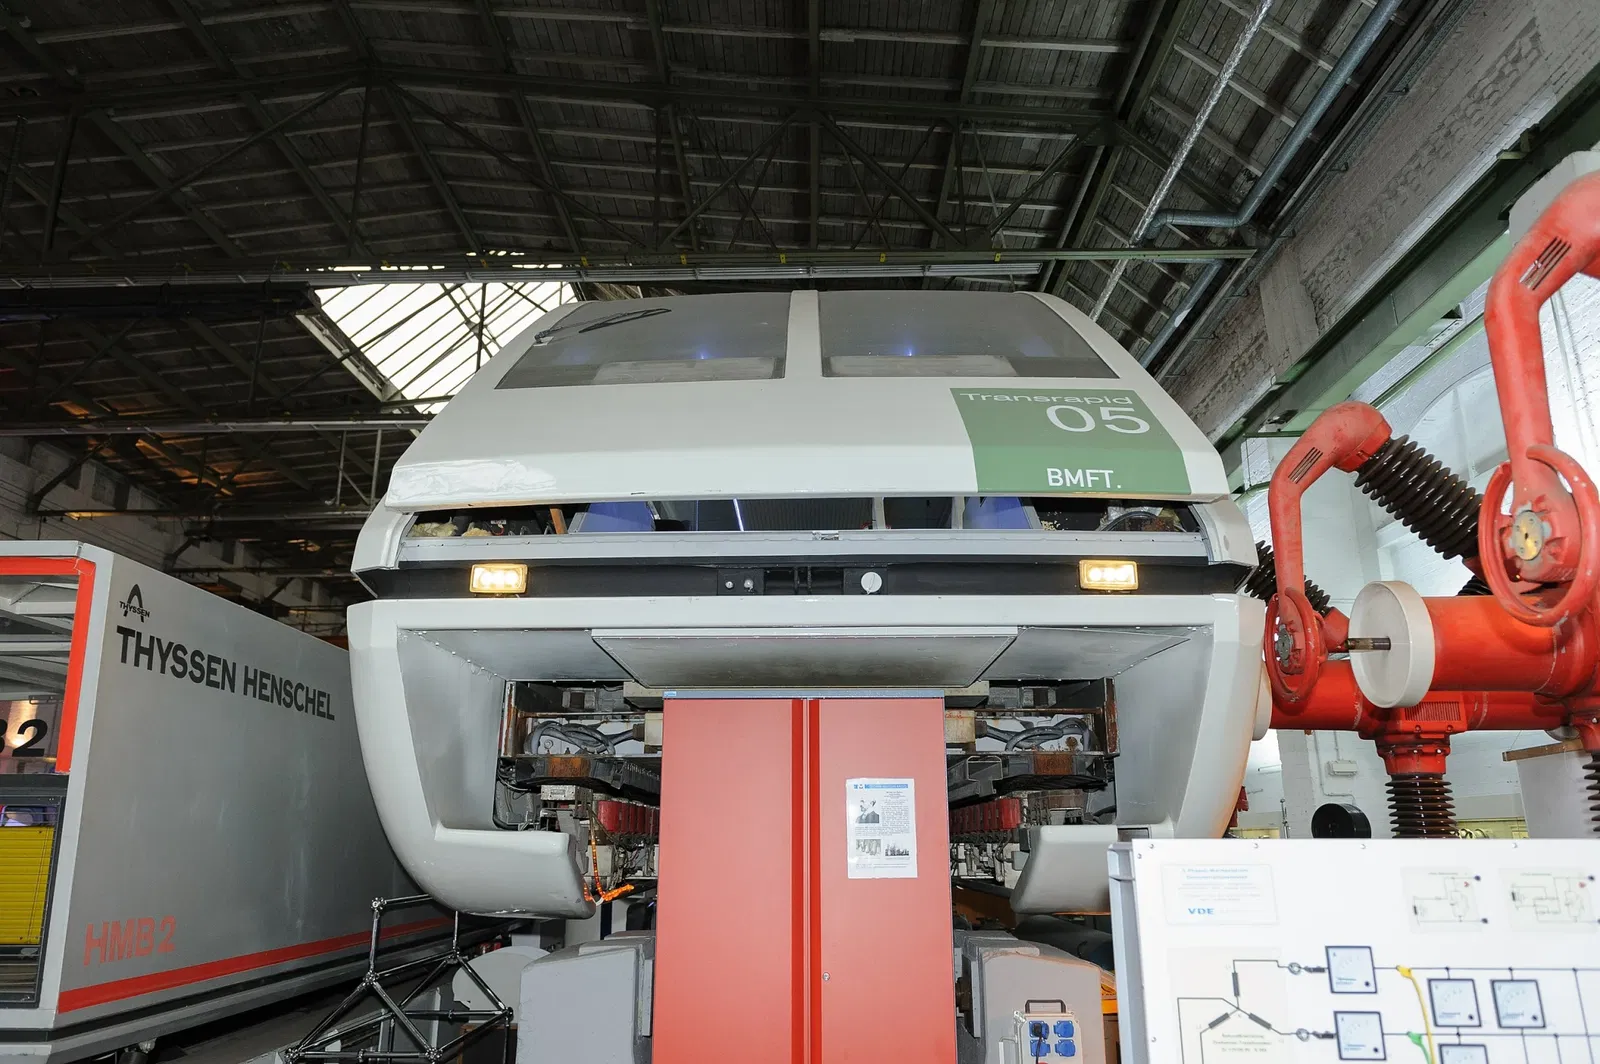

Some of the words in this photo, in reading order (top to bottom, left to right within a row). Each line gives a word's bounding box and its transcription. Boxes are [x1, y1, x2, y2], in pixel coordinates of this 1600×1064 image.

[960, 392, 1133, 405] Transrapid
[1046, 405, 1150, 434] 05
[119, 601, 150, 618] THYSSEN
[116, 625, 236, 693] THYSSEN
[243, 665, 335, 720] HENSCHEL
